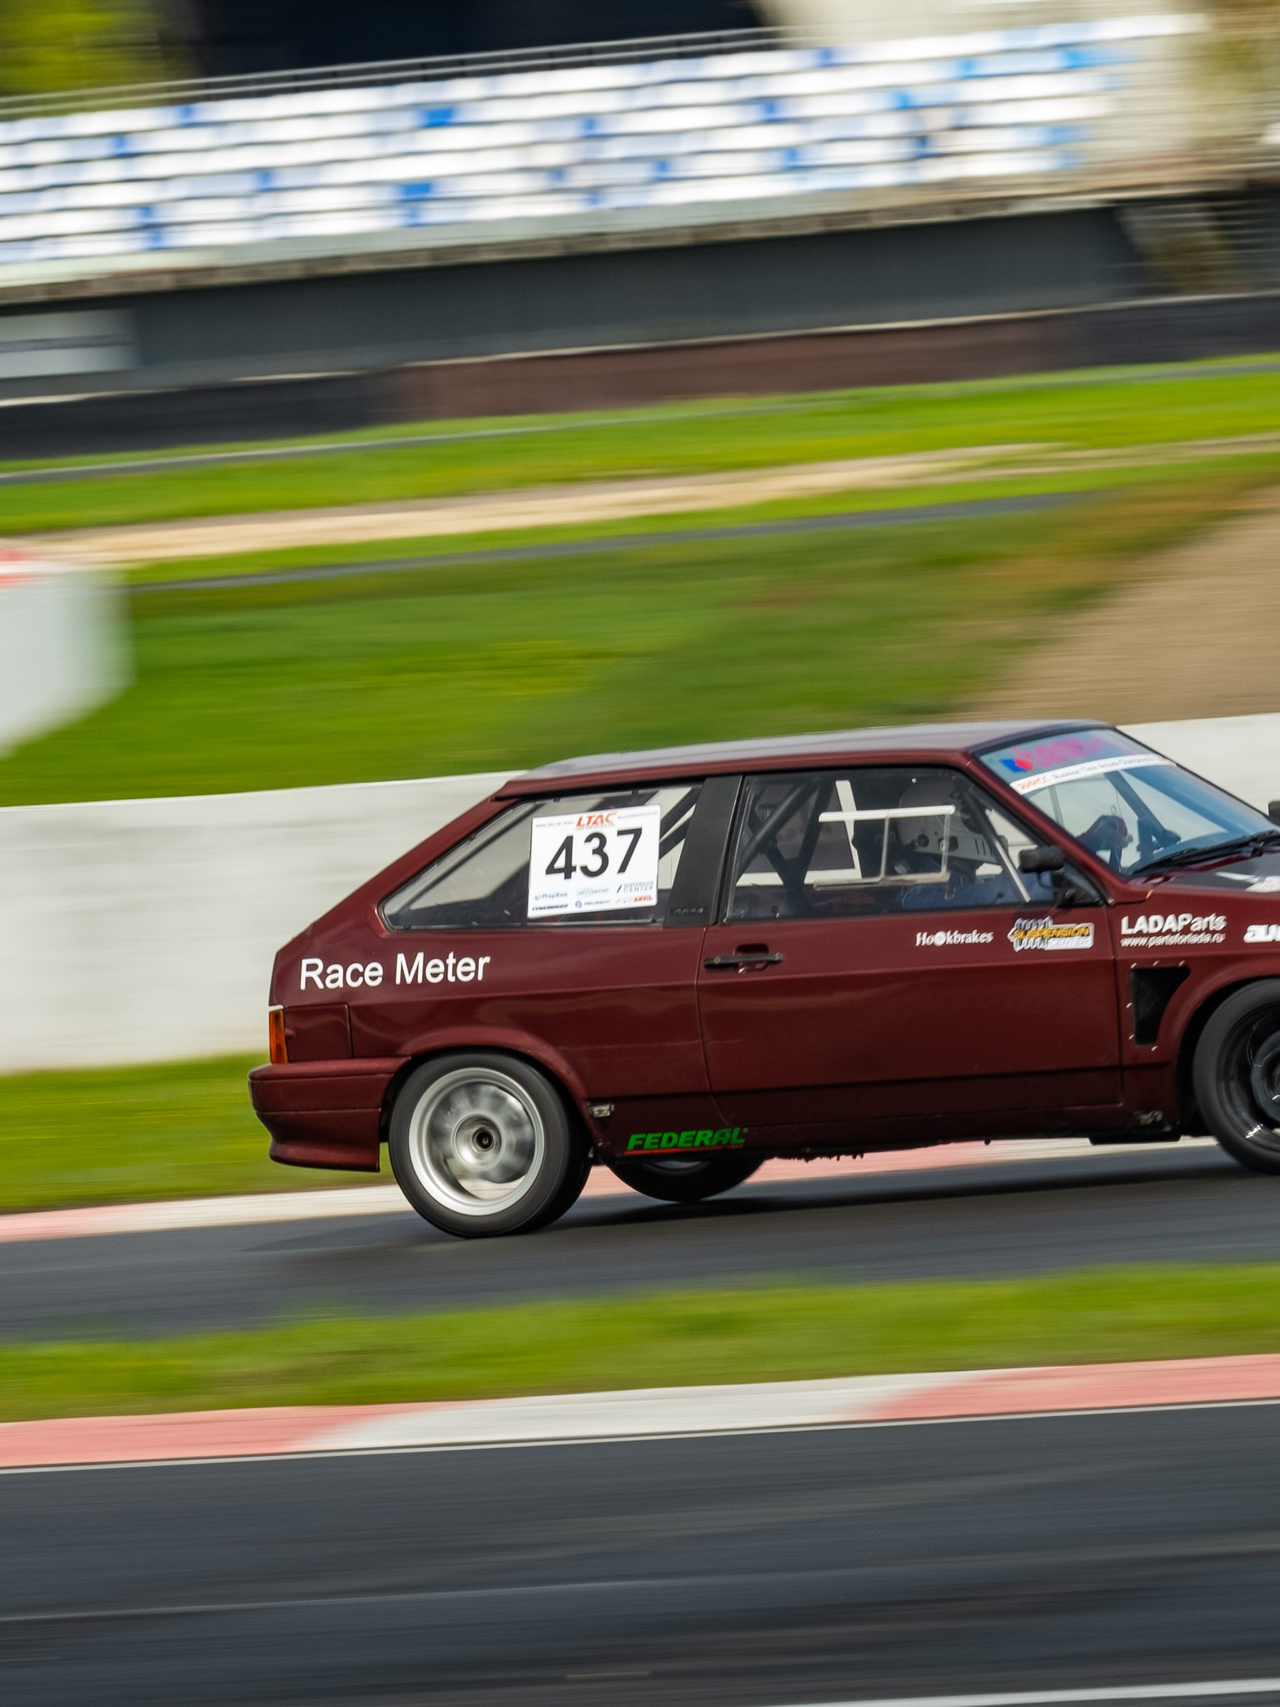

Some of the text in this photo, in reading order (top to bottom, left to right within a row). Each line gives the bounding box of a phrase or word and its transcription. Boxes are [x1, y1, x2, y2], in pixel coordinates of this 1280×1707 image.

[576, 811, 618, 828] LTAC
[545, 827, 643, 880] 437
[1120, 912, 1228, 935] LADAParts
[300, 951, 491, 991] Race Meter
[626, 1127, 746, 1151] FEDERAL
